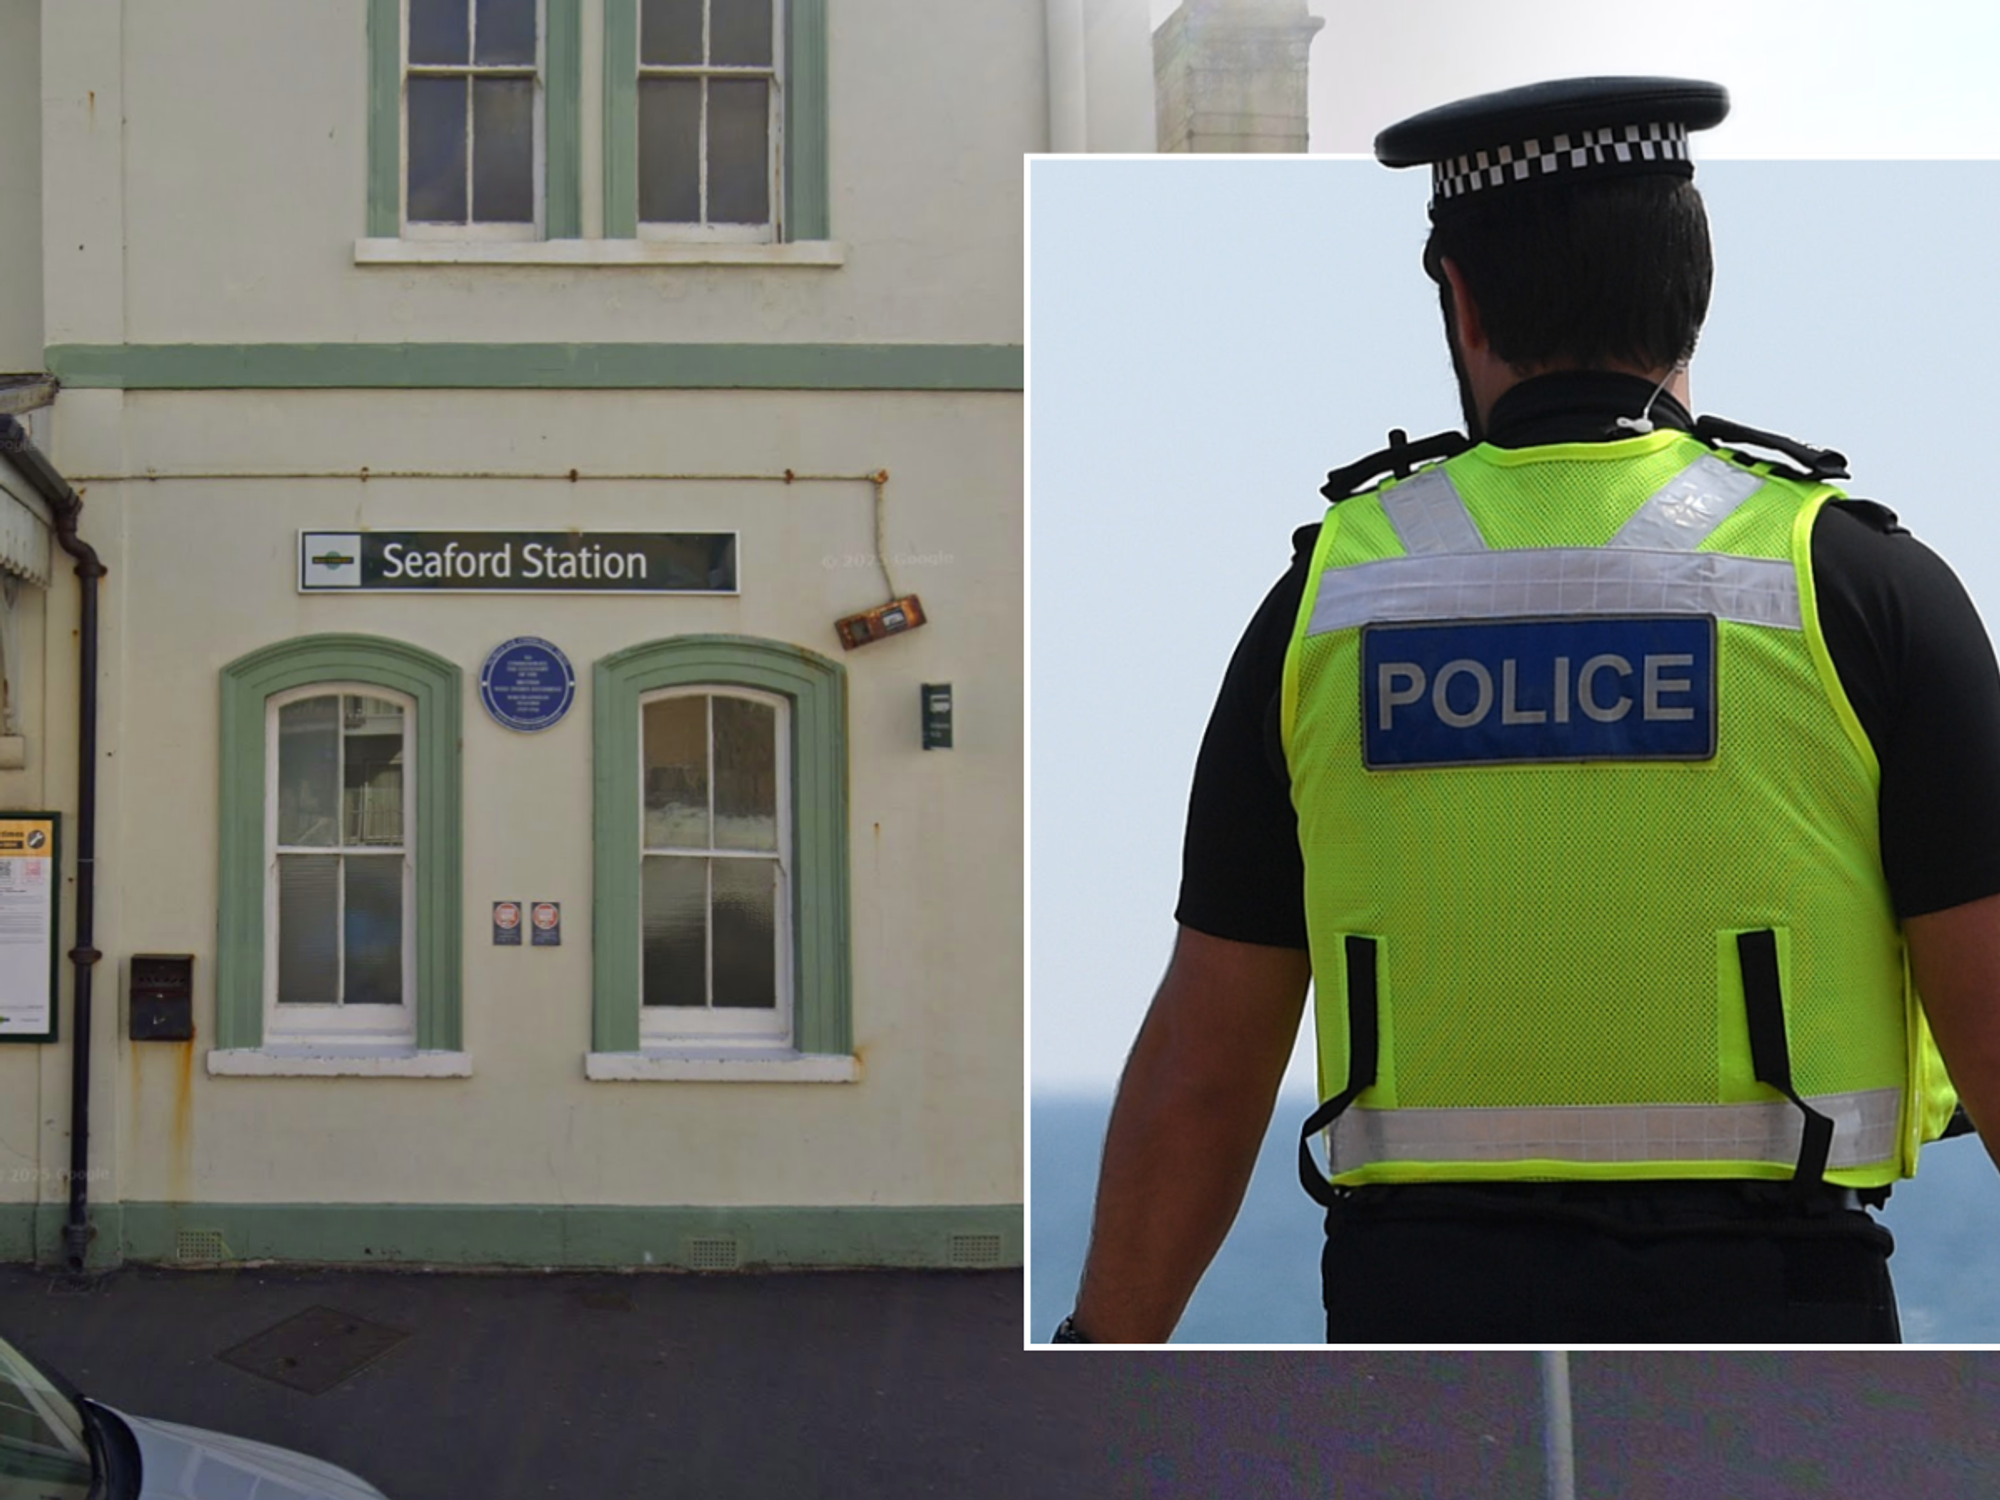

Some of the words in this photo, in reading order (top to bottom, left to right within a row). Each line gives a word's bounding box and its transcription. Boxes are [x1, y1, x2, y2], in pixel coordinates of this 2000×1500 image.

[382, 542, 512, 578] Seaford
[522, 544, 647, 579] Station
[1378, 654, 1695, 730] POLICE
